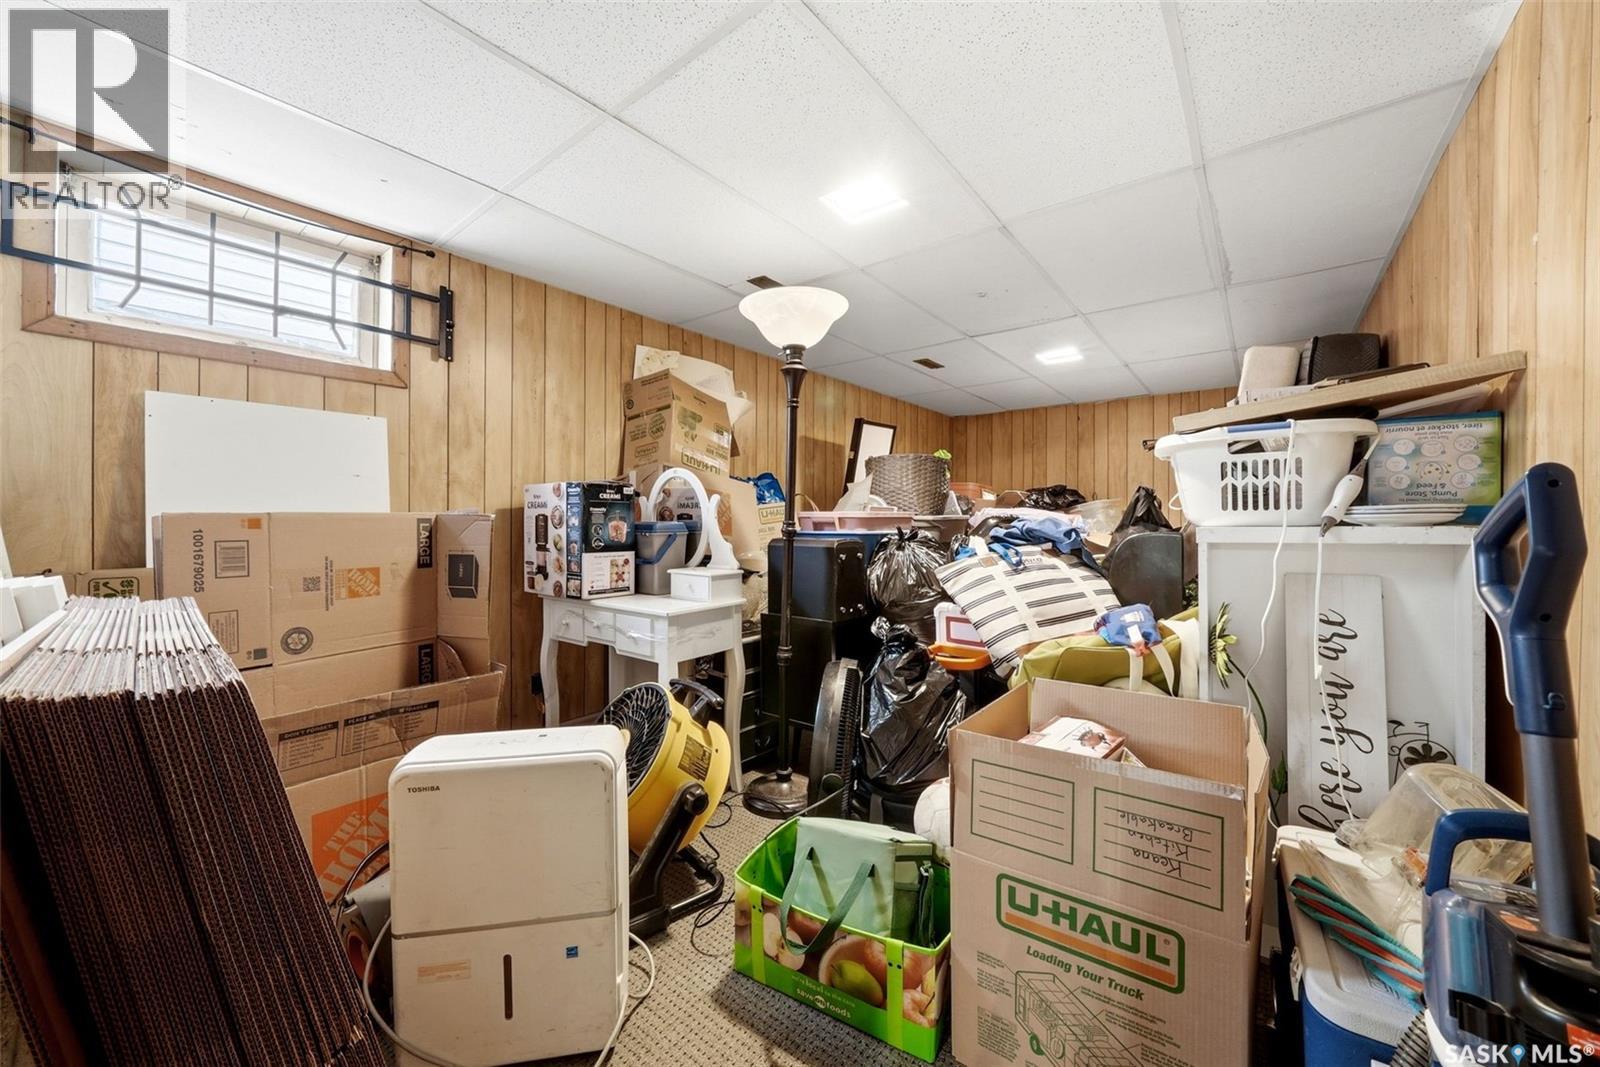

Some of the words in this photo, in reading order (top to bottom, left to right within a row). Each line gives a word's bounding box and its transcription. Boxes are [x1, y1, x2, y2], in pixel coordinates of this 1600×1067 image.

[1385, 426, 1414, 434] nourrir
[1427, 424, 1459, 432] stocker
[192, 529, 204, 593] 1001679025
[419, 522, 431, 565] LARGE
[1315, 608, 1357, 661] are
[420, 648, 432, 684] LARG
[1319, 671, 1374, 754] you
[407, 785, 441, 793] TOSHIBA
[323, 811, 365, 852] THE
[1116, 810, 1194, 843] Breakable
[1127, 829, 1190, 862] Kitchen
[1007, 886, 1171, 967] U-HAUL
[1026, 945, 1073, 974] Loading
[1075, 963, 1105, 985] Your
[1106, 976, 1146, 1001] Truck
[796, 988, 814, 1001] save
[826, 1001, 851, 1018] foods
